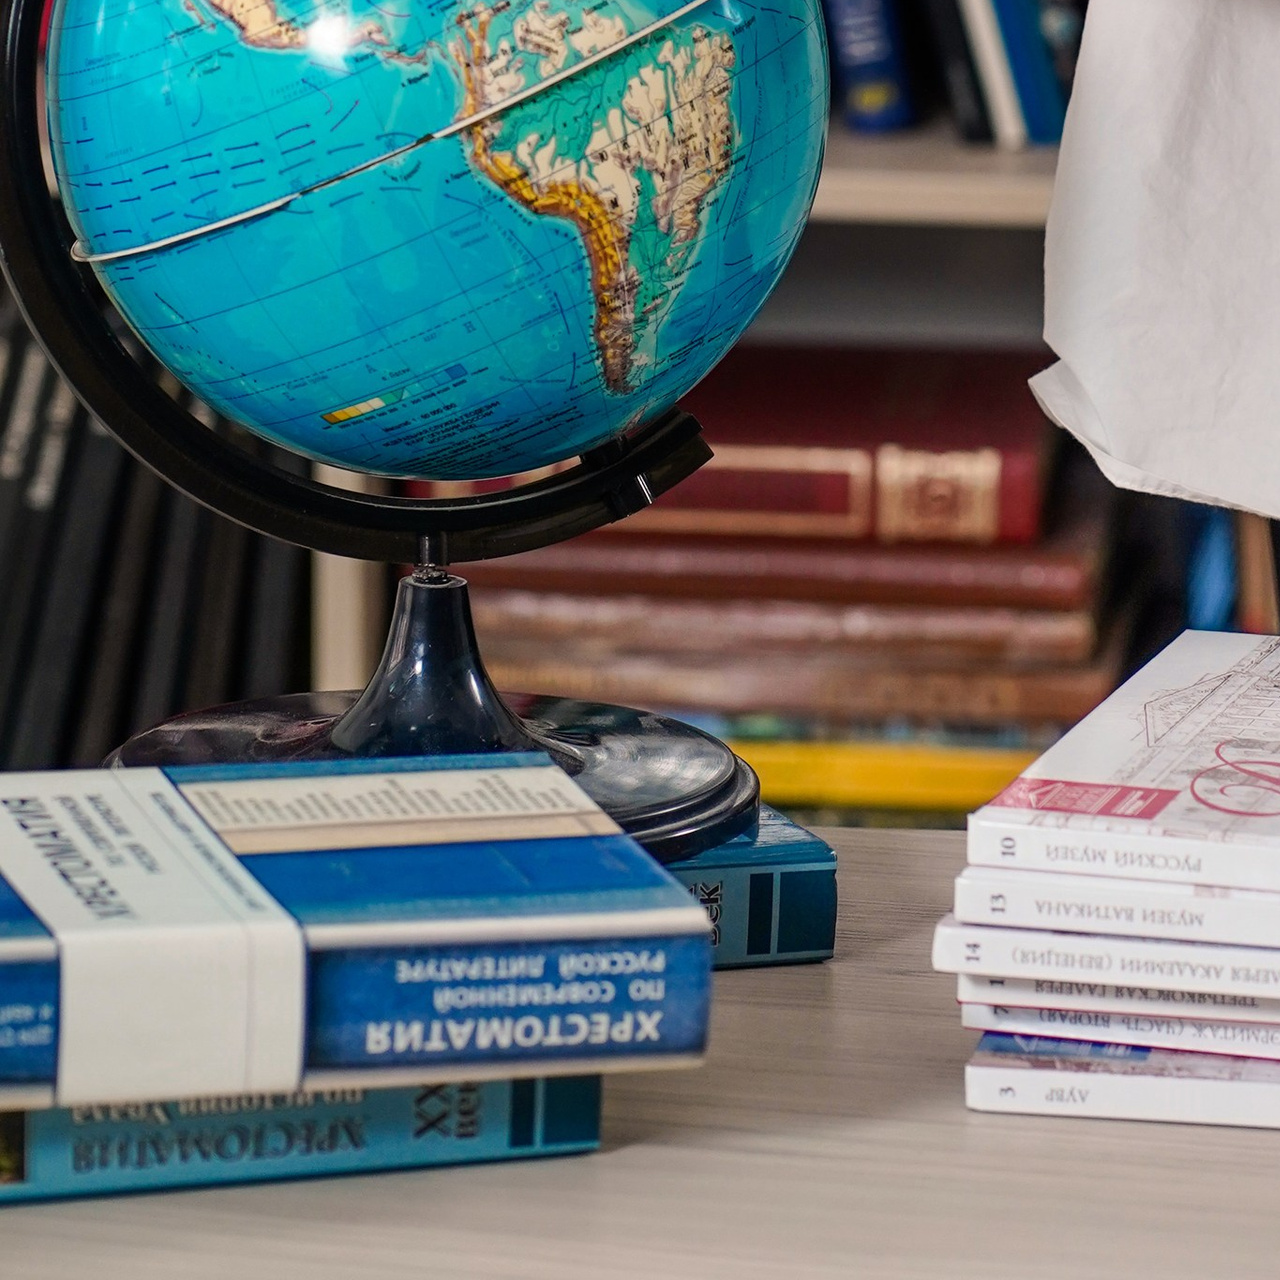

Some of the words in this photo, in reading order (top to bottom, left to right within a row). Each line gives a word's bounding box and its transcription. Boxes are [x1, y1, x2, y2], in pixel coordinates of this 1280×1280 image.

[1000, 836, 1017, 859] 10
[1044, 843, 1107, 864] МУЗЕЙ
[1113, 851, 1203, 874] РУССКИЙ
[989, 893, 1007, 915] 13
[1034, 898, 1136, 923] ВАТИКАНА
[1141, 908, 1205, 928] МУЗЕИ
[965, 942, 981, 963] 14
[1011, 947, 1113, 973] (ВЕНЕЦИЯ)
[395, 953, 547, 984] ЛИТЕРАТУРЕ
[558, 949, 667, 981] РУССКОЙ
[1119, 955, 1225, 981] АКАДЕМИИ
[432, 979, 619, 1015] СОВРЕМЕННОЙ
[627, 978, 667, 1002] ПО
[365, 1009, 665, 1056] ХРЕСТОМАТИЯ
[1119, 1016, 1186, 1039] (ЧАСТЬ
[999, 1085, 1015, 1097] 3
[1044, 1087, 1091, 1104] ЛУВР
[71, 1114, 367, 1174] ХРЕСТОМАТИЯ
